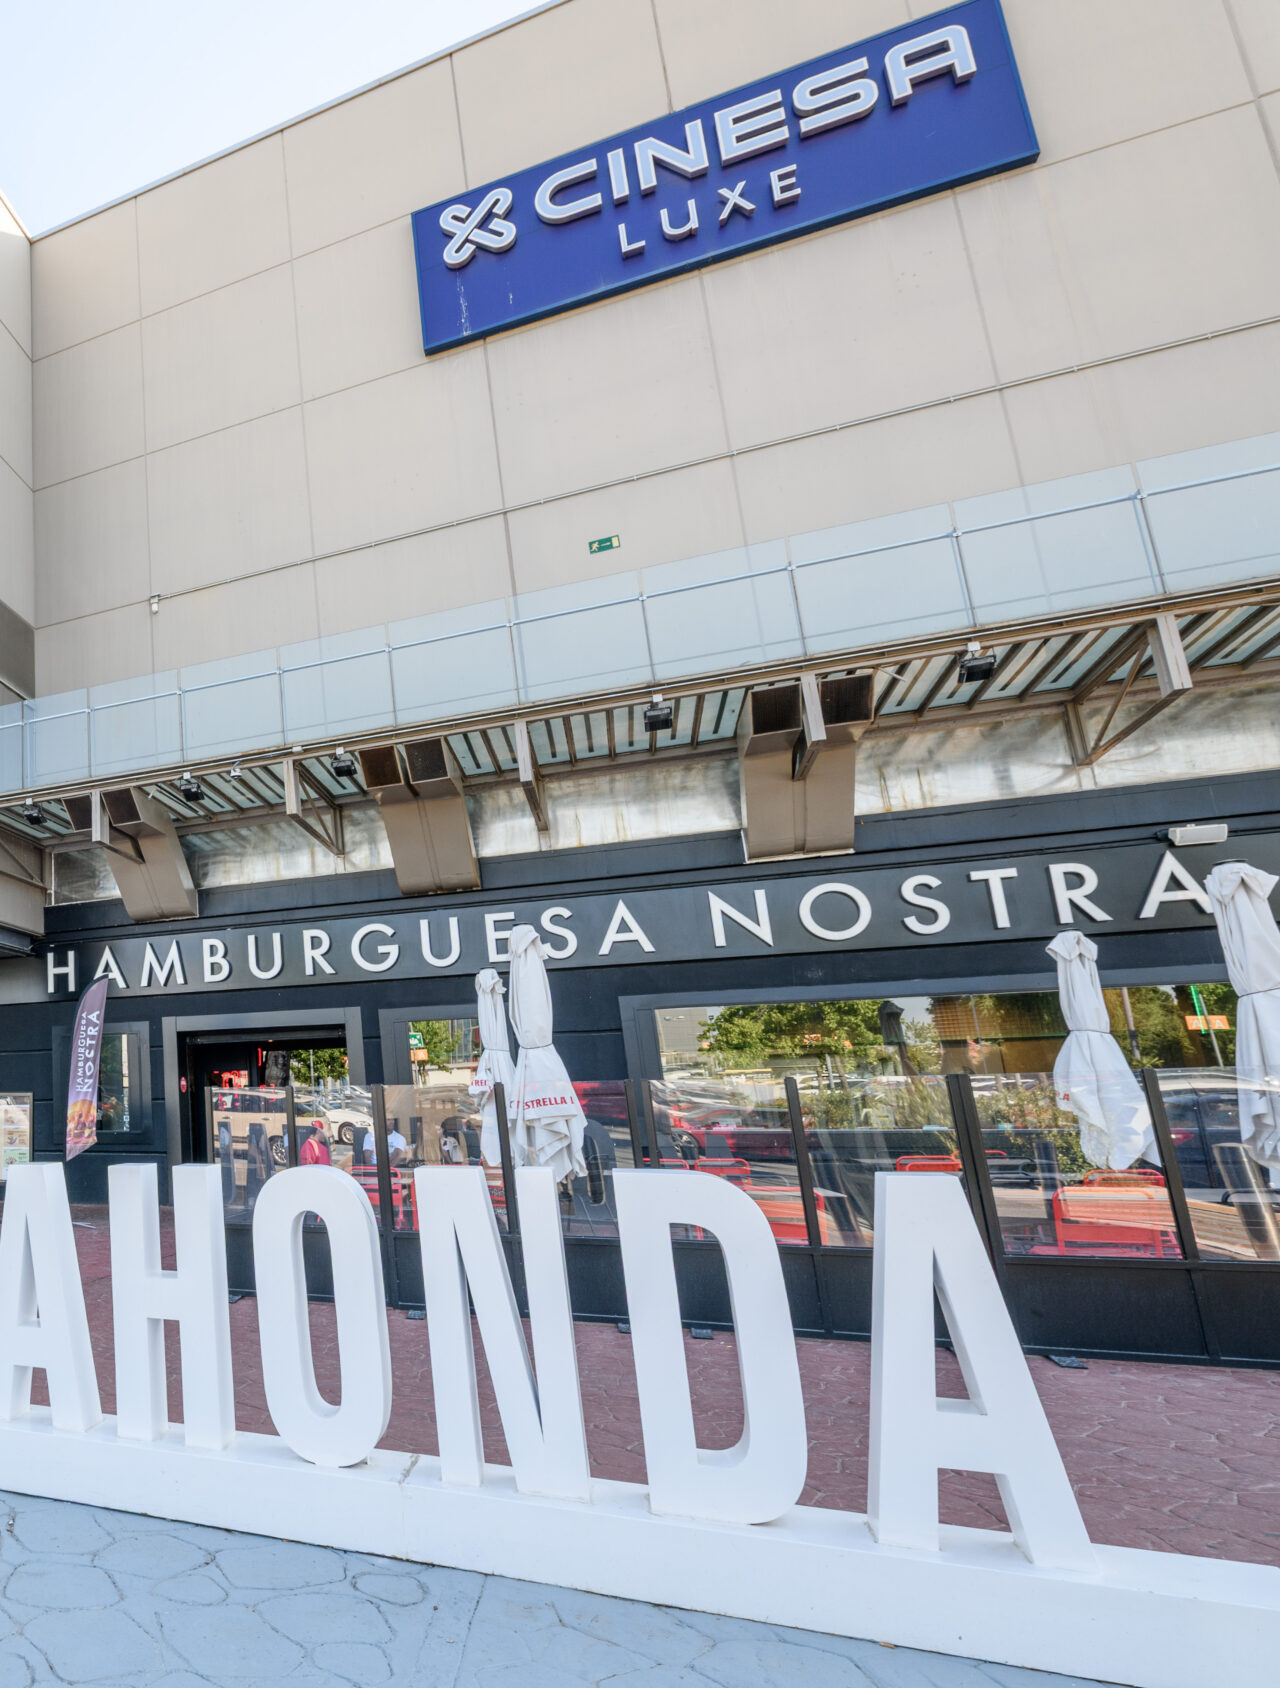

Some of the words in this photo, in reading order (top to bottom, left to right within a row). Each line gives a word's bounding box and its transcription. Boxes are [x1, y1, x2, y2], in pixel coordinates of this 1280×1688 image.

[534, 24, 977, 225] CINESA
[618, 164, 802, 259] LUXE
[46, 899, 656, 994] HAMBURGUESA
[707, 849, 1216, 947] NOSTRA
